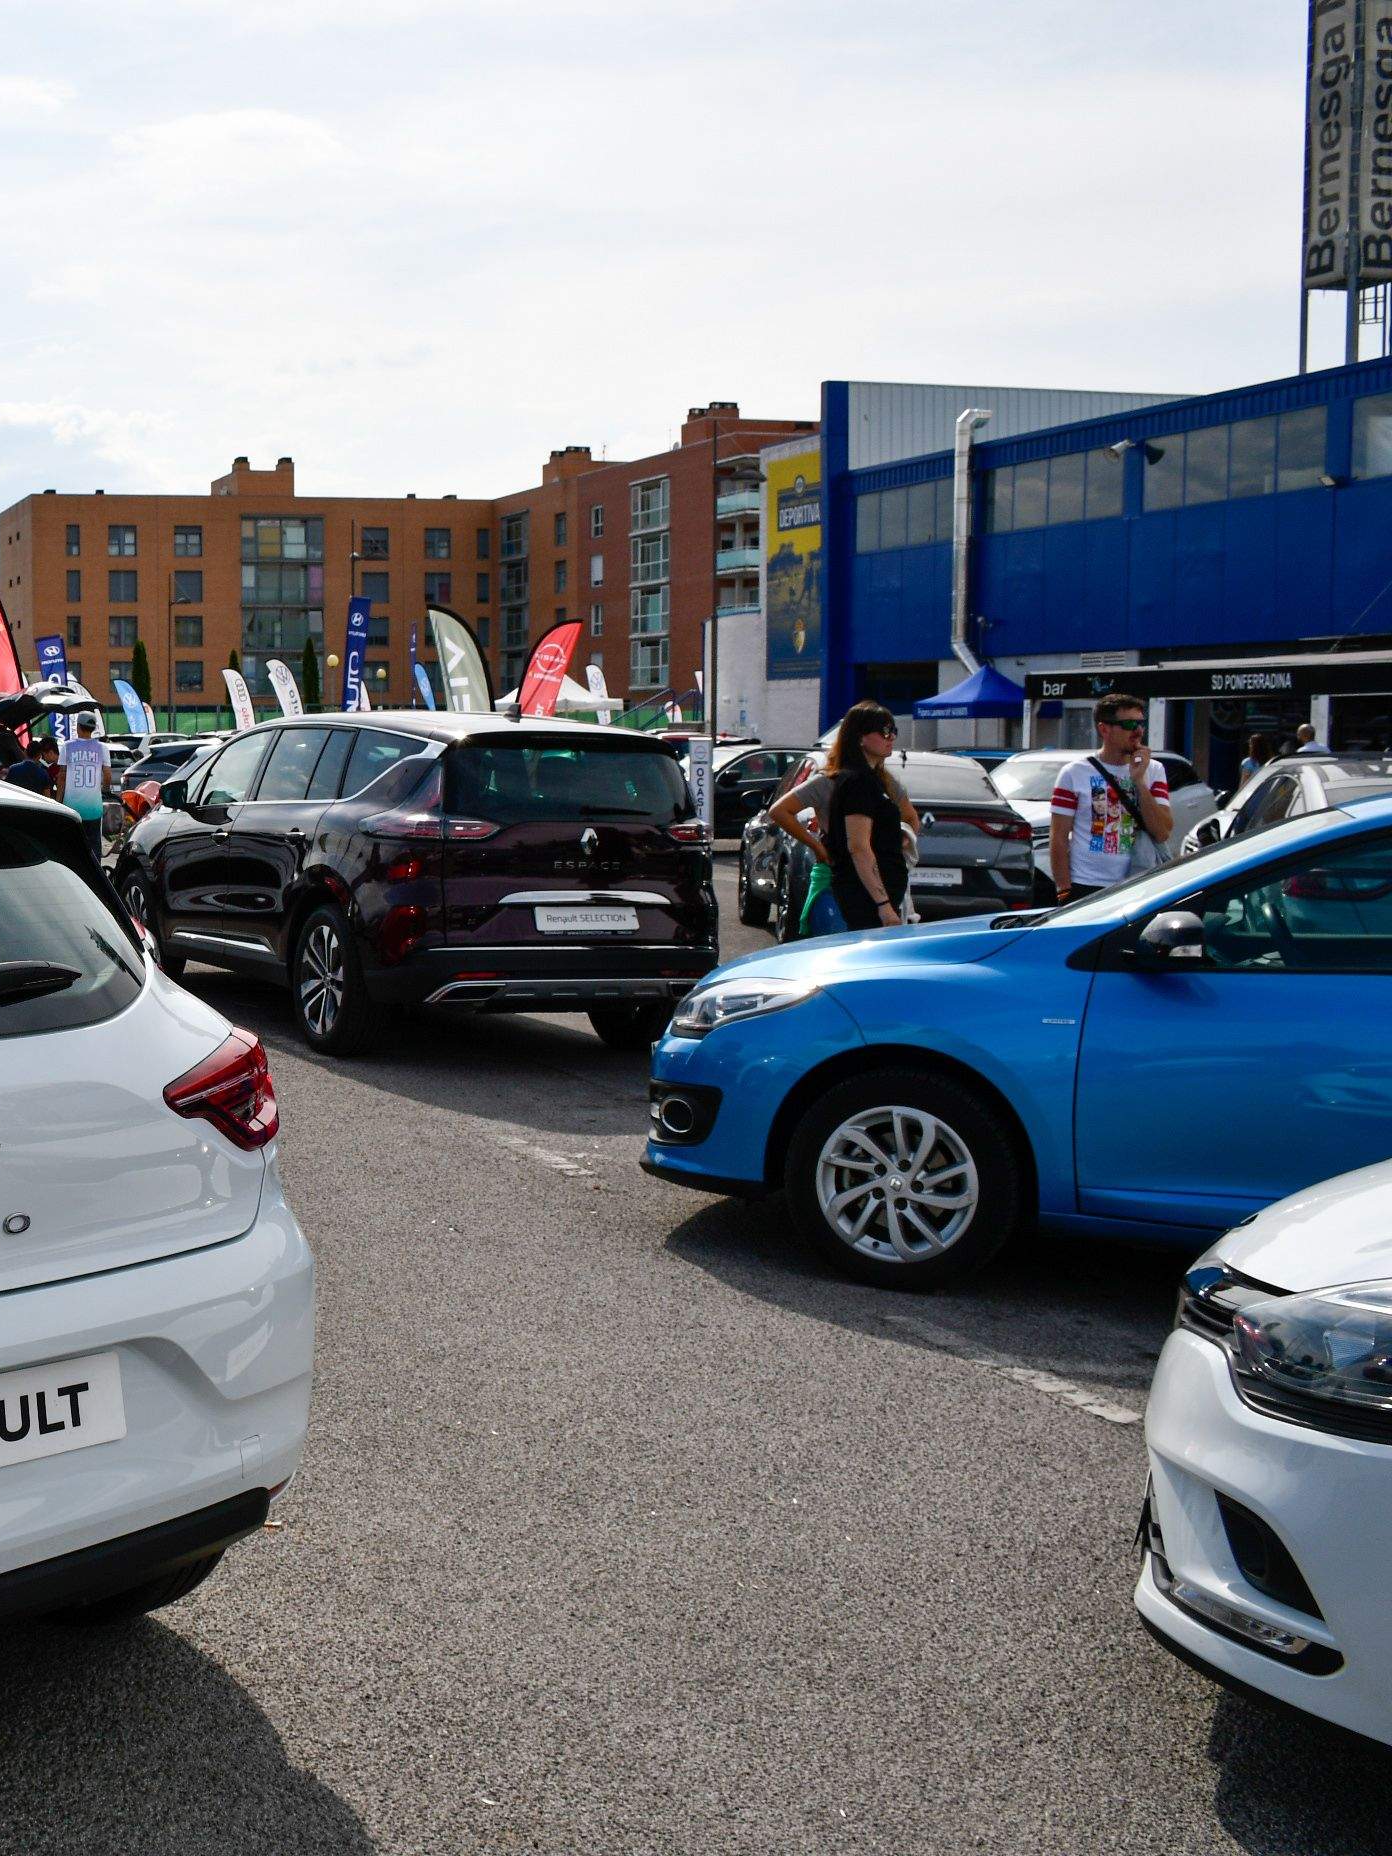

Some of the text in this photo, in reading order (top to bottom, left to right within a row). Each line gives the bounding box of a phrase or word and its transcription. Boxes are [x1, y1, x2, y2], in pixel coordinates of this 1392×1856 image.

[1308, 22, 1352, 278] Bernesga
[779, 502, 820, 528] DEPORTIVA
[1043, 680, 1067, 697] bar
[1211, 672, 1292, 691] SD PONFERRADINA
[70, 751, 99, 763] MIAMI
[74, 765, 96, 788] 30
[696, 768, 705, 817] OCASI
[546, 913, 627, 924] Renault SELECTION
